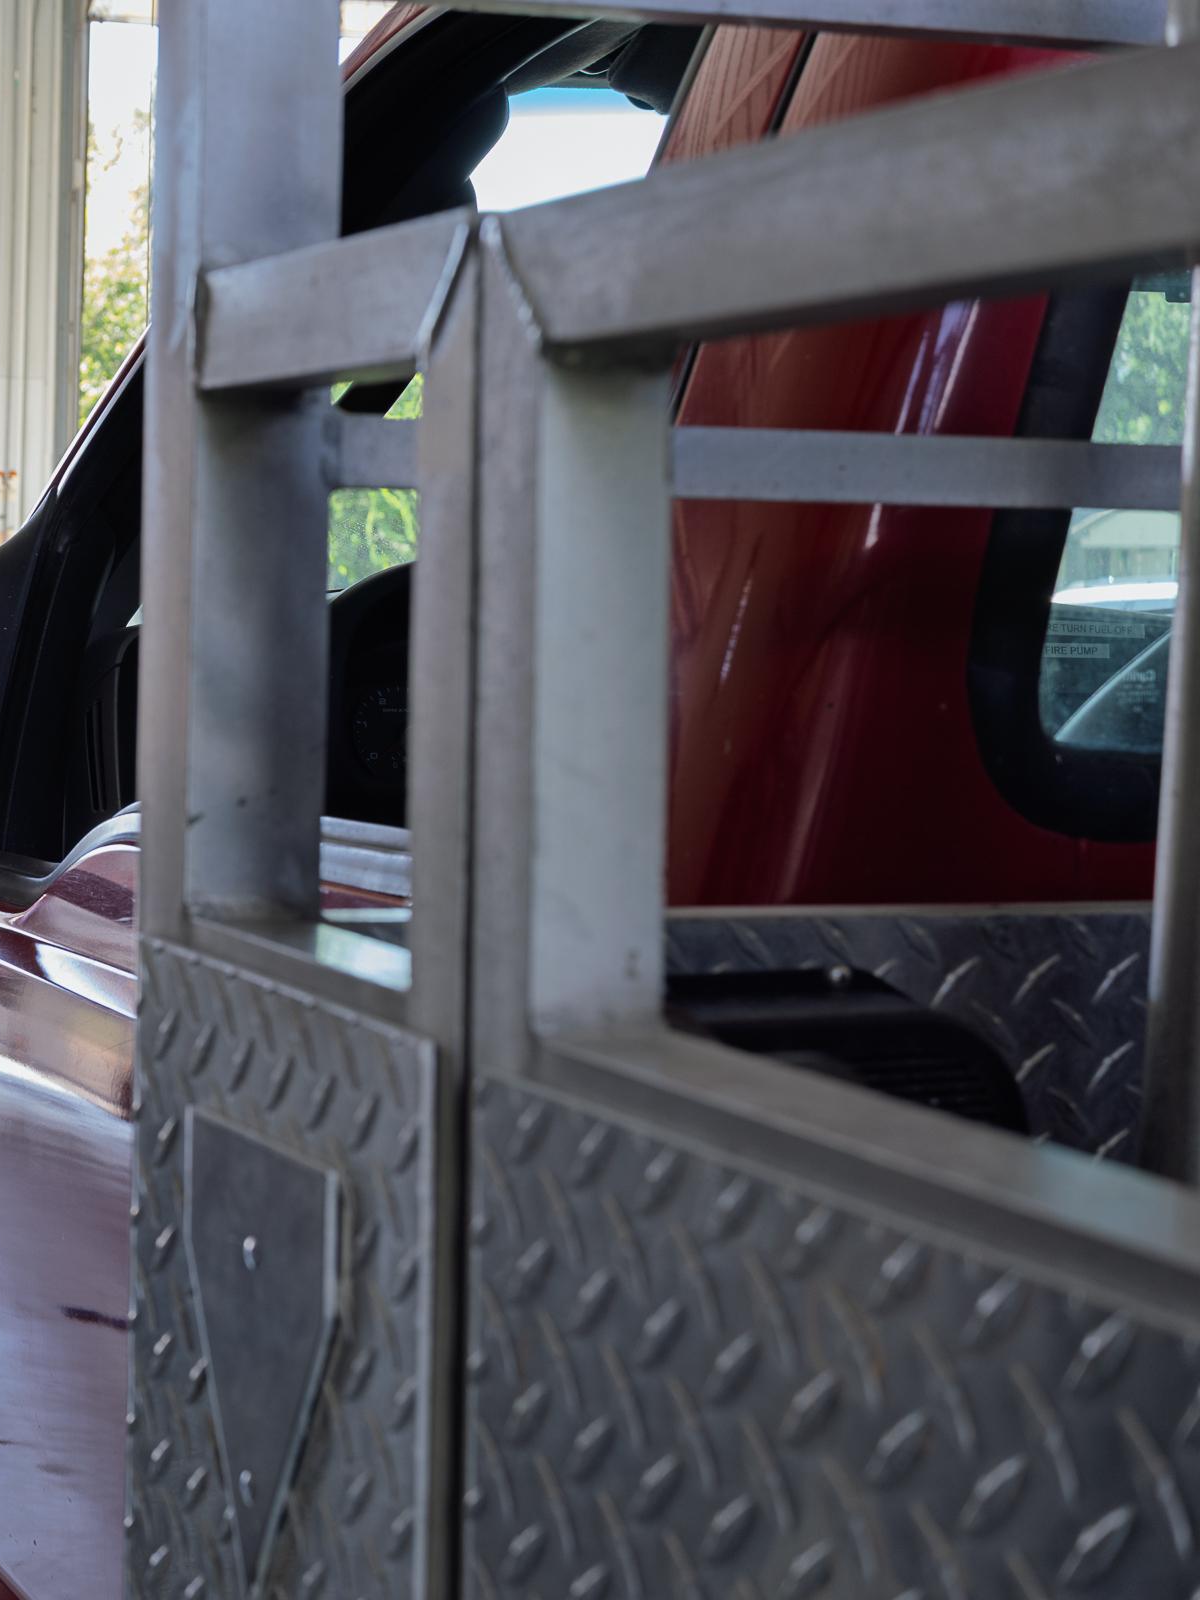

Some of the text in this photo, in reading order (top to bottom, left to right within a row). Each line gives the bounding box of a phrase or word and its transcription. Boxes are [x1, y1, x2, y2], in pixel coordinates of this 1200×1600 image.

[1060, 623, 1087, 633] TURN
[1044, 645, 1098, 656] FIRE PUMP
